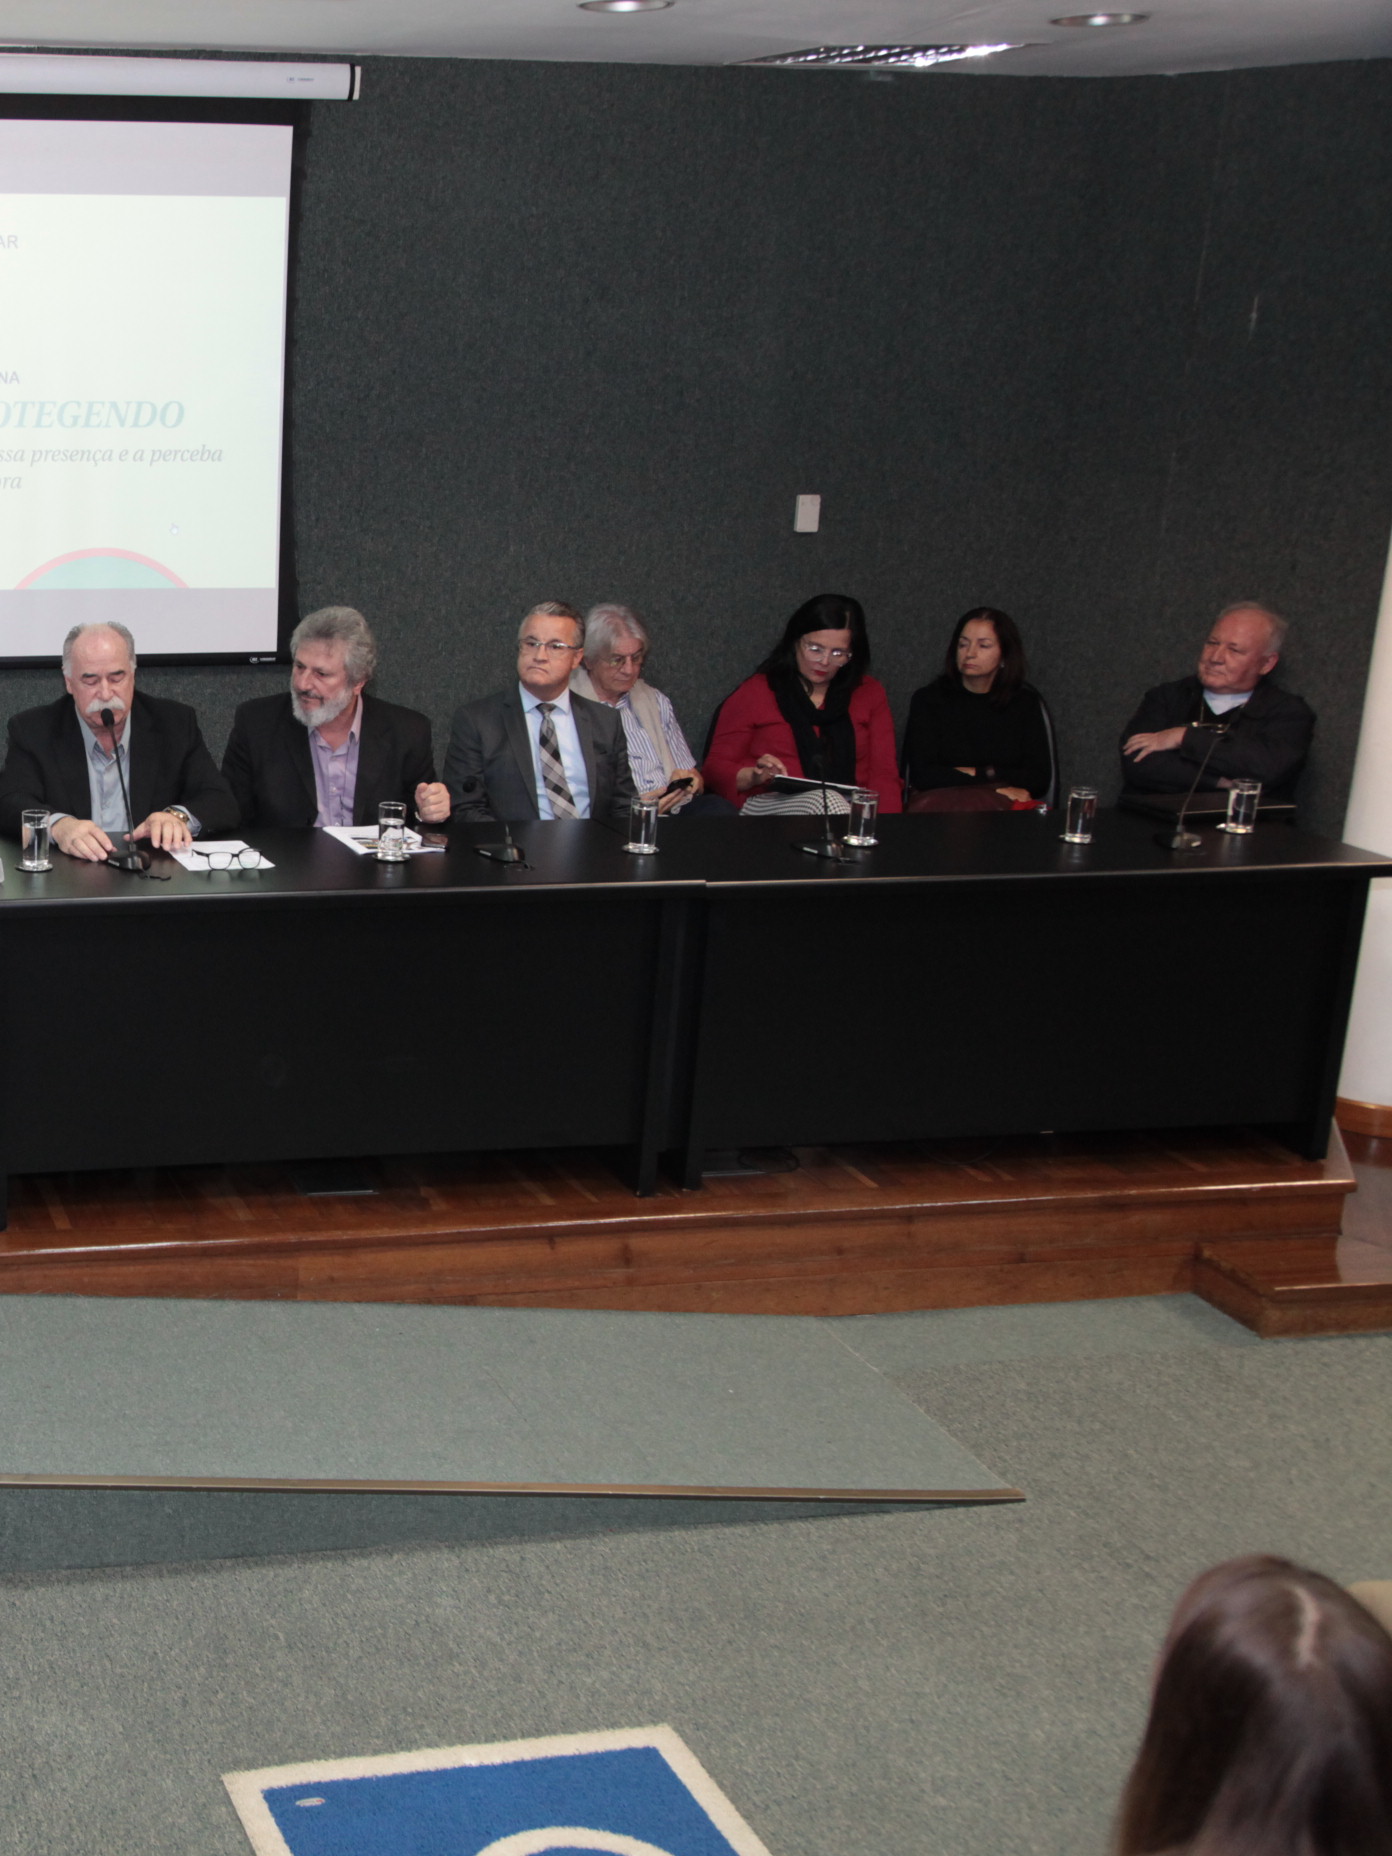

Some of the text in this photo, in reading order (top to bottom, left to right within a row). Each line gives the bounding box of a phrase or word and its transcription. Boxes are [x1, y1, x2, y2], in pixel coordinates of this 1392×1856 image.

[30, 449, 113, 467] presença
[118, 449, 129, 462] e
[132, 449, 144, 462] a
[149, 444, 223, 466] perceba
